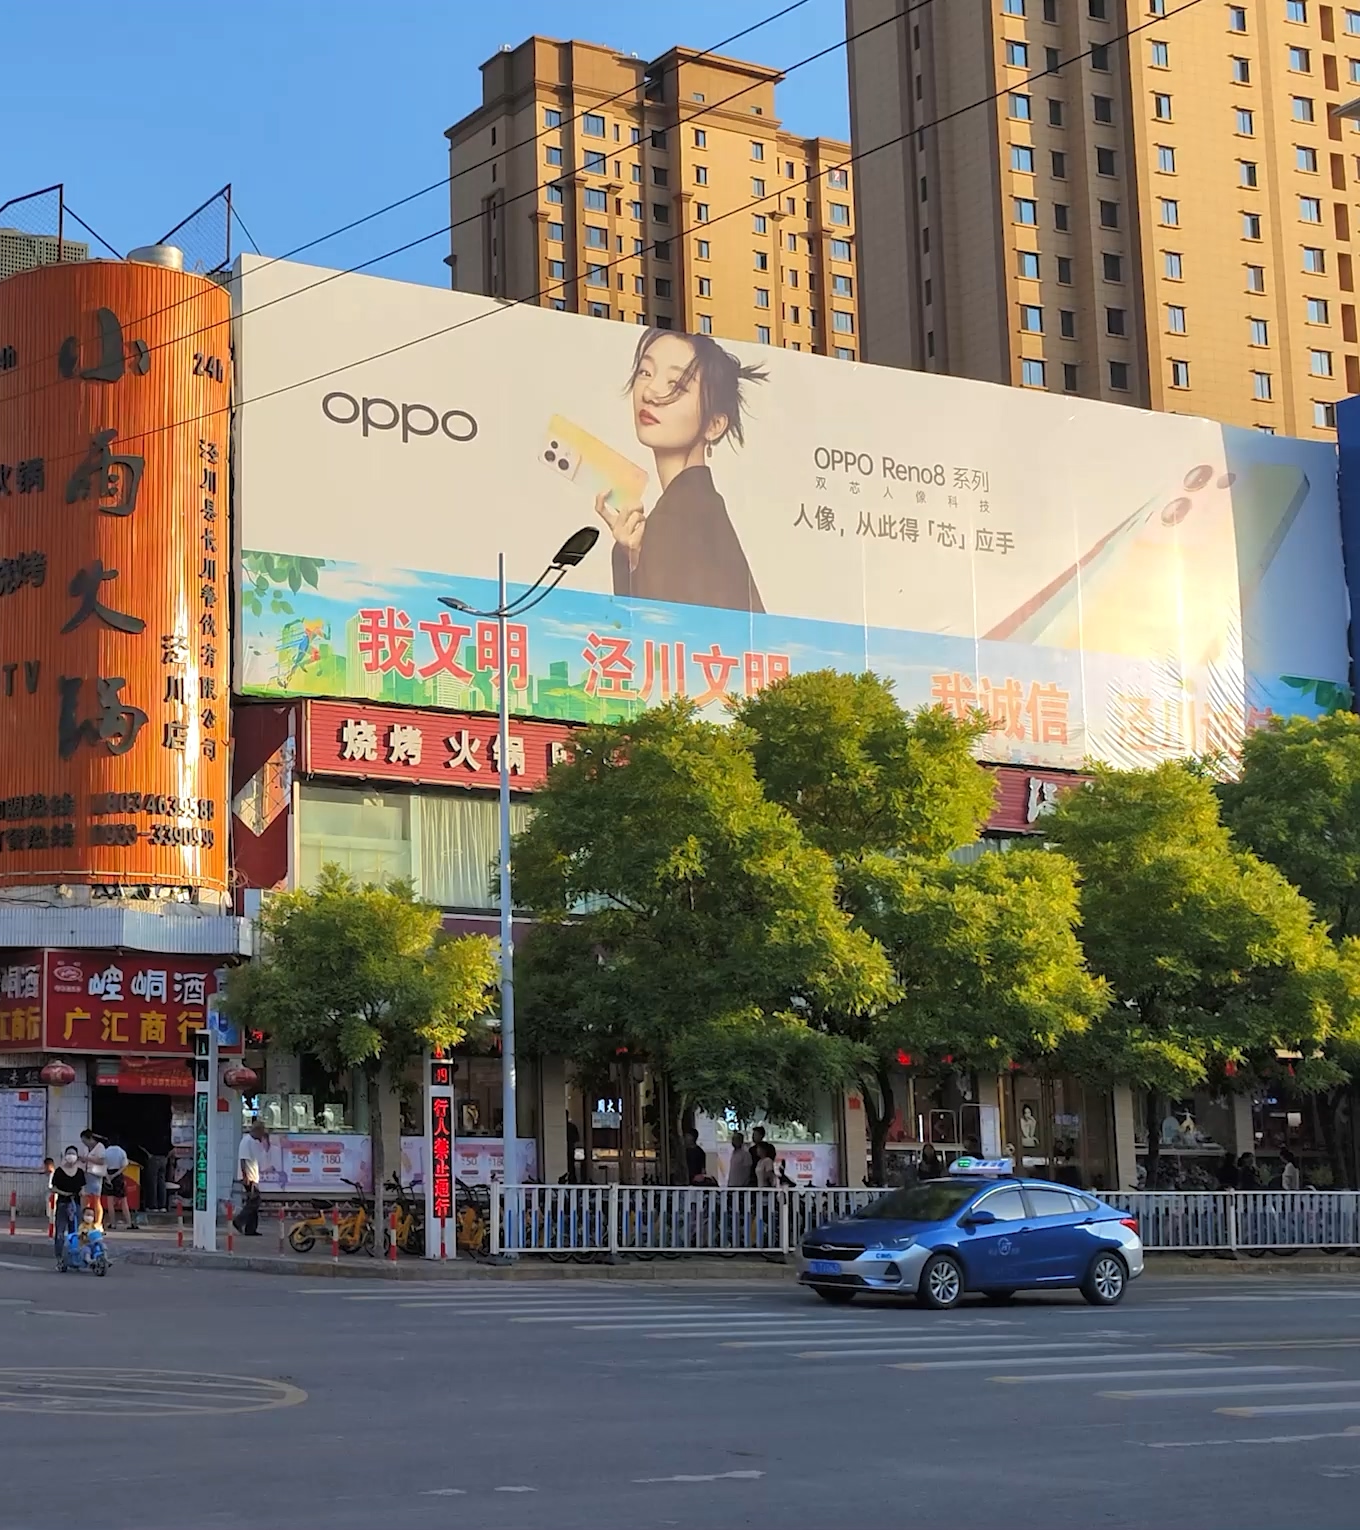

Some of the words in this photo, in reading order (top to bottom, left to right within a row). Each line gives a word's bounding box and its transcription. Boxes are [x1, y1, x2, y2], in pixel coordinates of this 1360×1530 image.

[193, 352, 223, 383] 24h
[814, 446, 874, 476] OPPO
[882, 456, 946, 486] Reno8
[952, 466, 990, 493] 系列
[198, 438, 218, 762] 泾川县长川餐饮有限公司
[357, 607, 529, 693] 我文明
[581, 631, 792, 708] 泾川文明
[931, 671, 1071, 746] 我诚信
[340, 718, 424, 767] 烧烤
[443, 728, 527, 777] 火锅
[88, 964, 208, 1006] 崆峒酒
[63, 1006, 205, 1046] 广汇商行
[433, 1098, 451, 1218] 行人禁止通行
